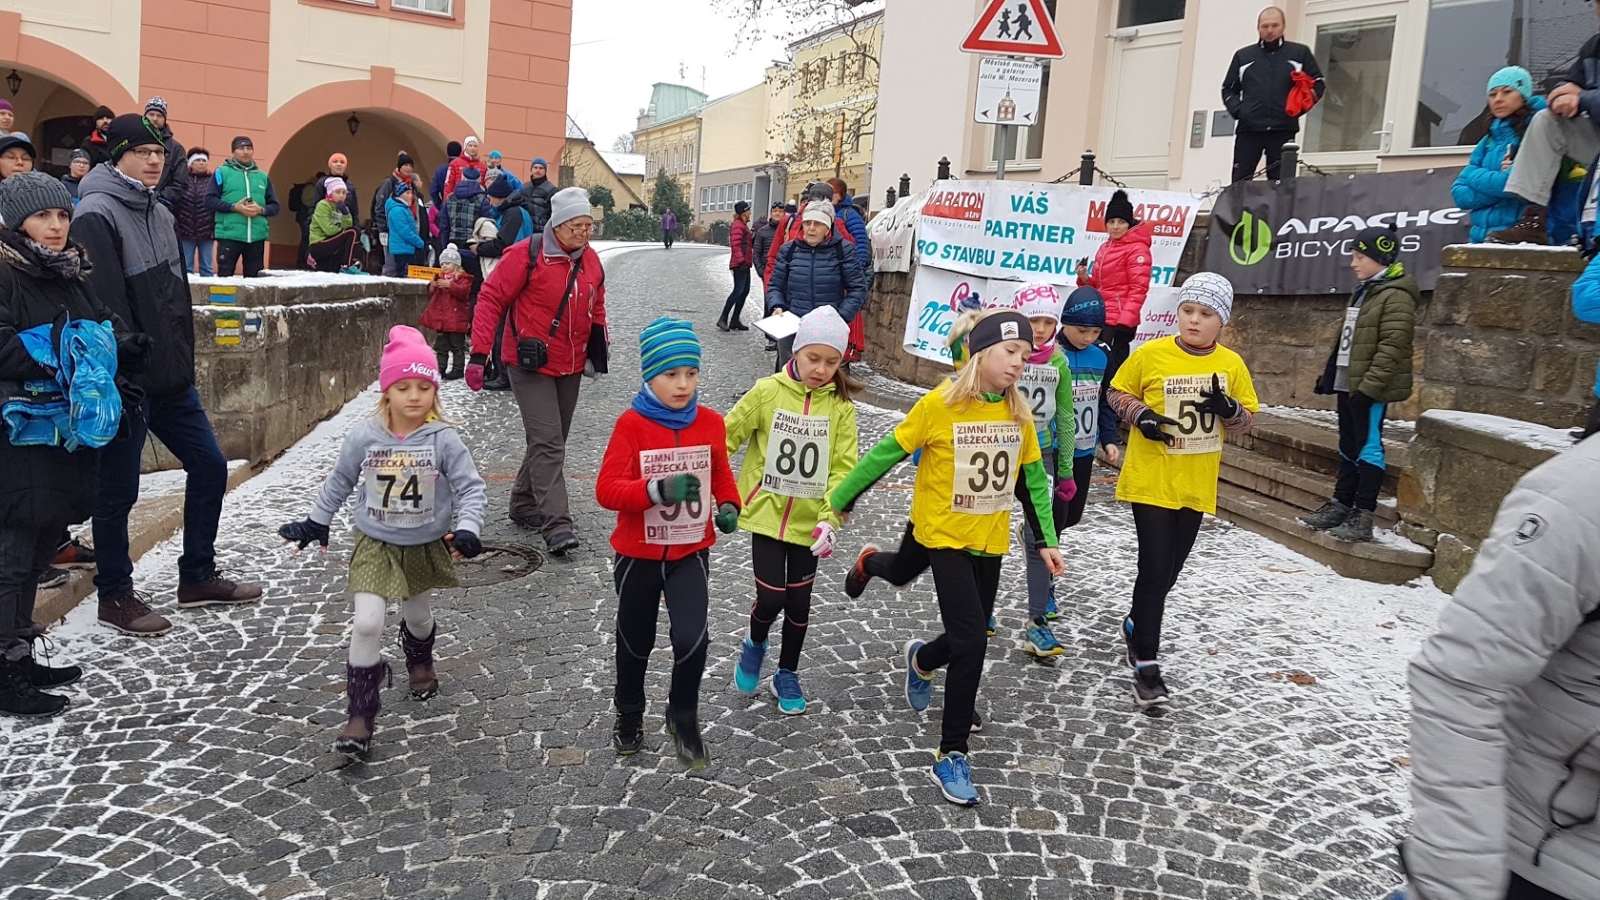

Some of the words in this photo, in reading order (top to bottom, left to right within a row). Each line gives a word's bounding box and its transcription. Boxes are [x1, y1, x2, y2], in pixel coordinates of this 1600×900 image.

[1011, 191, 1049, 215] VÁŠ
[964, 210, 981, 219] stav
[1089, 200, 1190, 223] MATON
[1154, 223, 1181, 234] stav
[1277, 207, 1468, 236] APACHE
[984, 219, 1075, 245] PARTNER
[1275, 234, 1421, 259] BICYCS
[917, 239, 938, 255] RO
[940, 243, 995, 266] STAVBU
[1000, 249, 1078, 276] ZÁBAVU
[1145, 309, 1178, 327] dorty,
[1041, 375, 1057, 383] LIGA
[1167, 377, 1193, 386] ZIMNÍ
[1167, 385, 1204, 395] BĚŽECKÁ
[776, 413, 800, 425] ZIMNÍ
[1178, 400, 1216, 435] 50
[774, 421, 810, 437] BĚŽECKÁ
[813, 429, 828, 437] LIGA
[957, 424, 987, 435] ZIMNÍ
[957, 434, 999, 445] BĚŽECKÁ
[1002, 435, 1020, 444] LIGA
[410, 459, 433, 467] LIGA
[643, 451, 675, 464] ZIMNÍ
[776, 438, 819, 479] 80
[644, 462, 688, 475] BĚŽECKÁ
[692, 461, 709, 470] LIGA
[968, 451, 1010, 493] 39
[376, 474, 422, 509] 74
